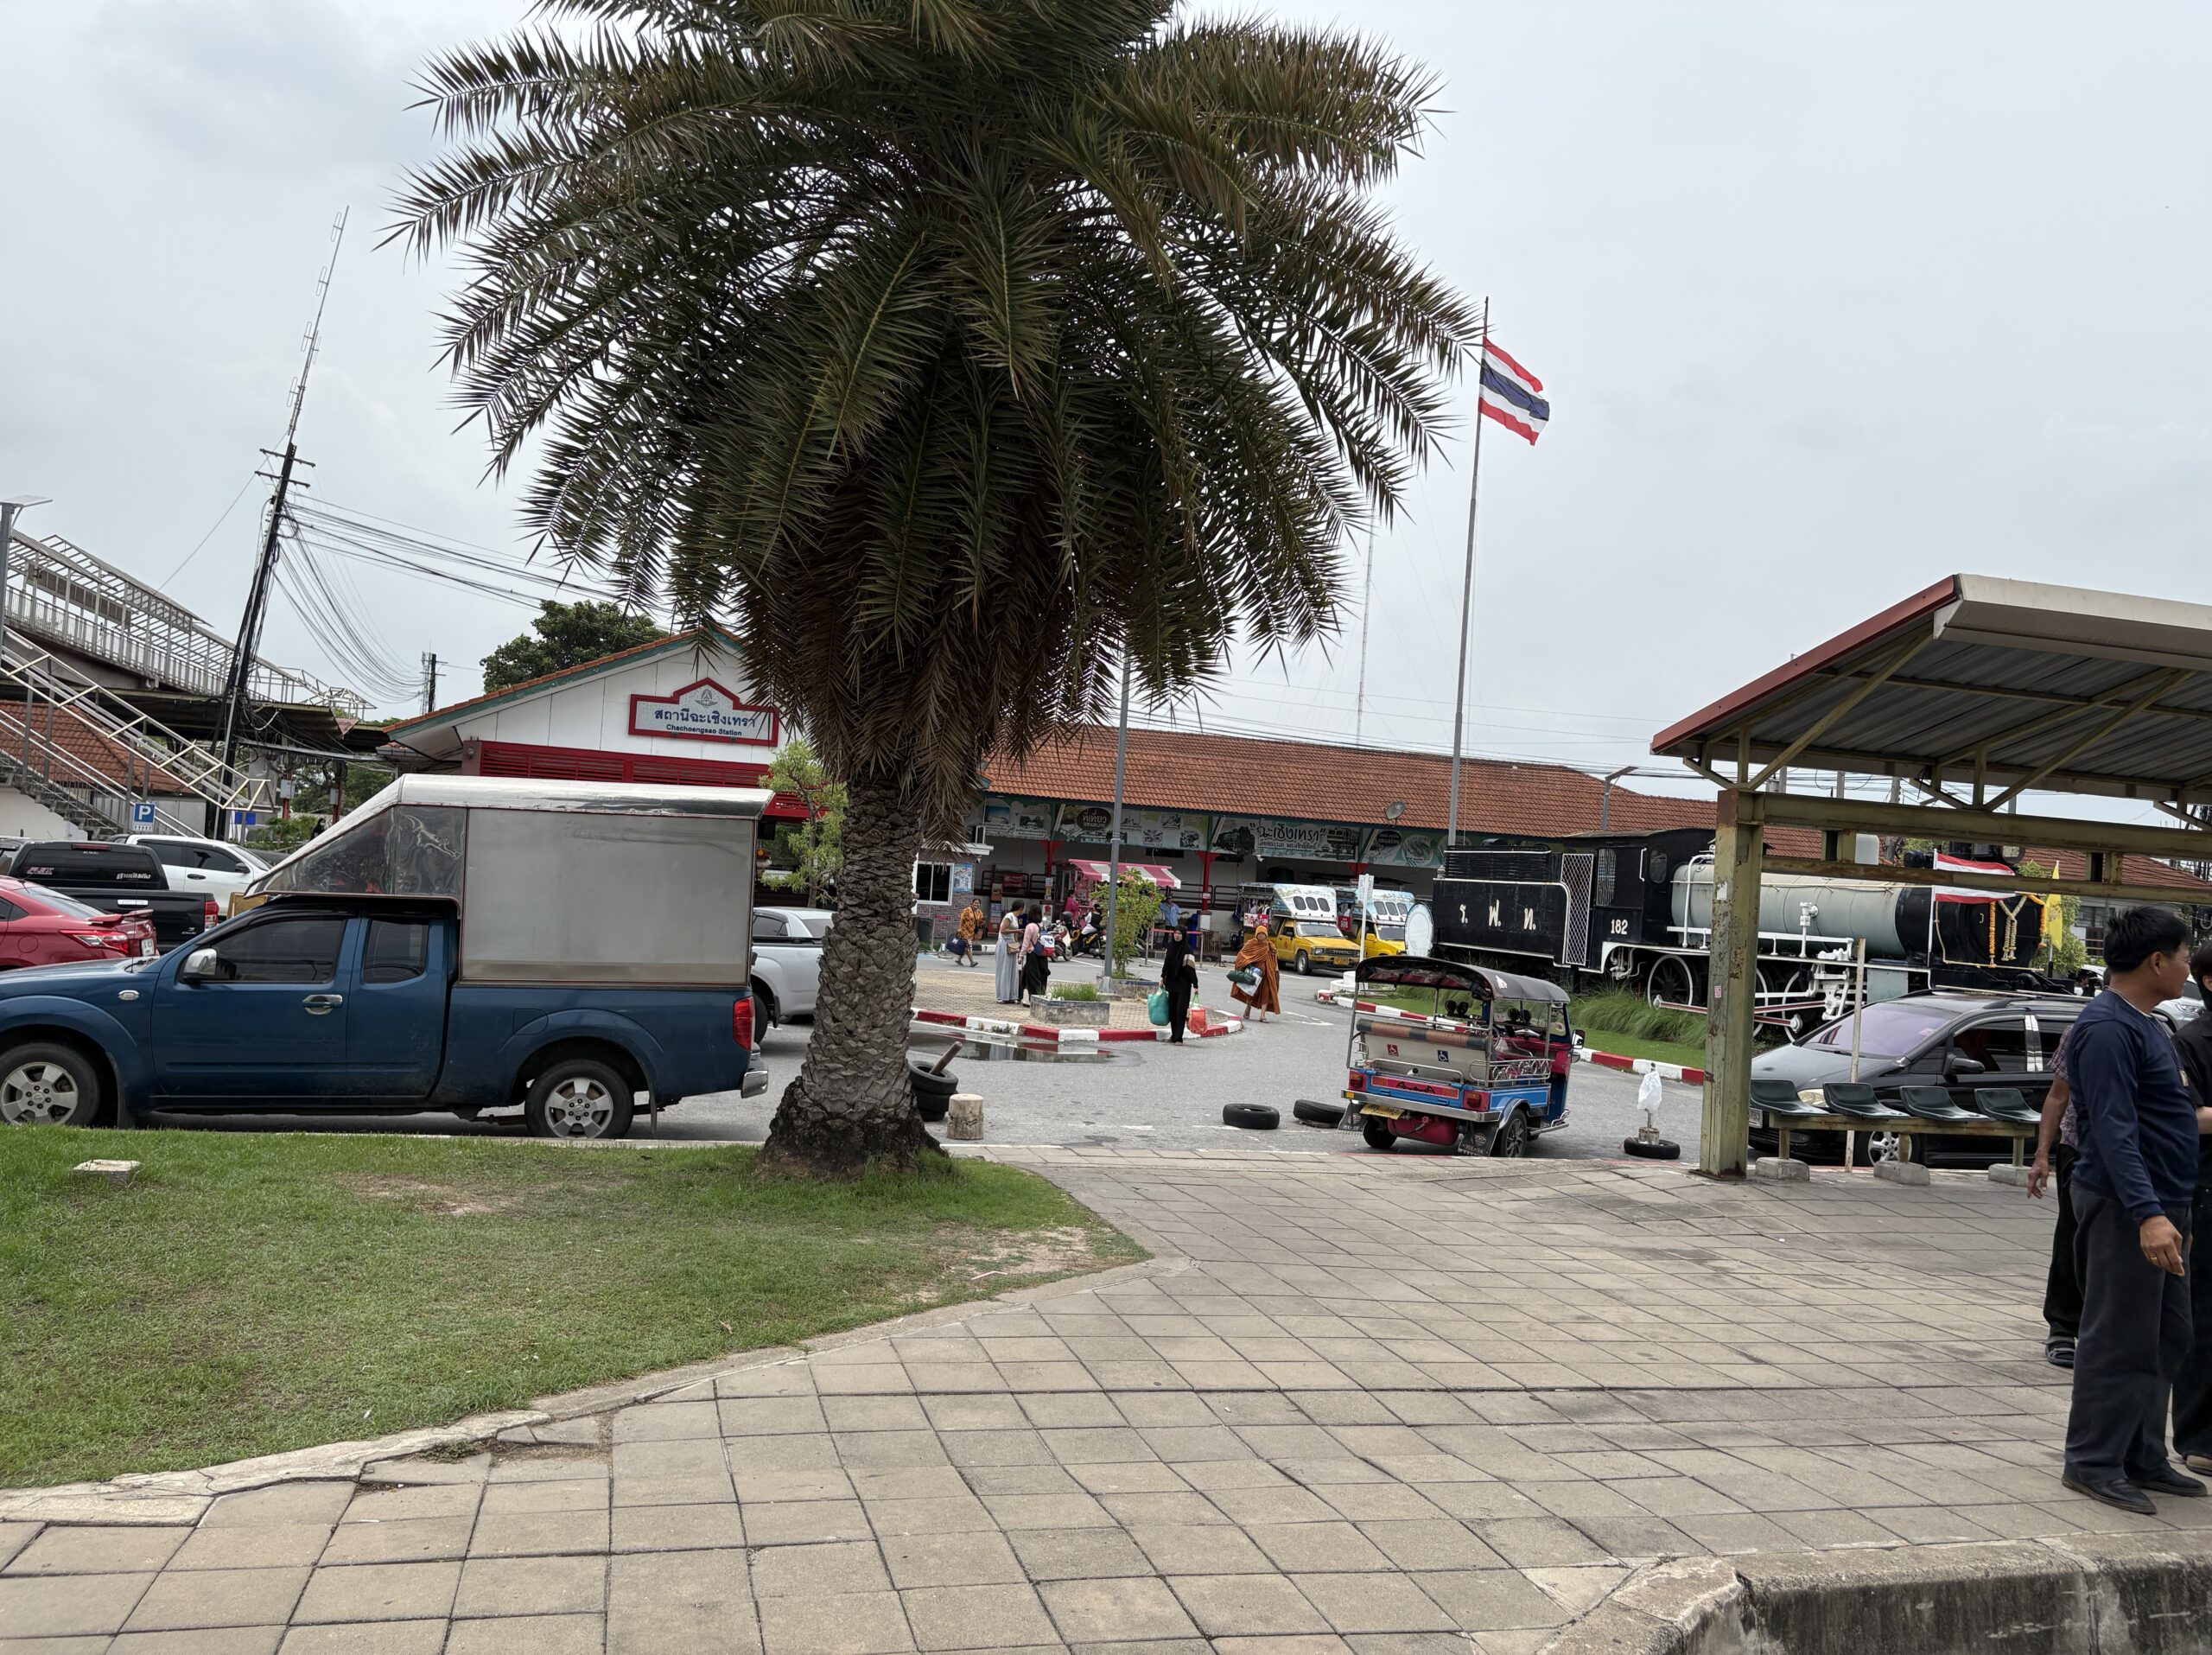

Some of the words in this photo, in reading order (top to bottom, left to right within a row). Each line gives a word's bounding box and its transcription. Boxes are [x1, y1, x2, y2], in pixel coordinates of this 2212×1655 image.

[654, 708, 755, 728] สถานีฉะเชิงเทรา
[666, 723, 717, 735] Chachoengsao
[138, 805, 151, 820] P
[1459, 903, 1468, 924] ร.
[1488, 899, 1502, 927] ฟ.
[1523, 907, 1536, 931] ท.
[1611, 919, 1628, 935] 182
